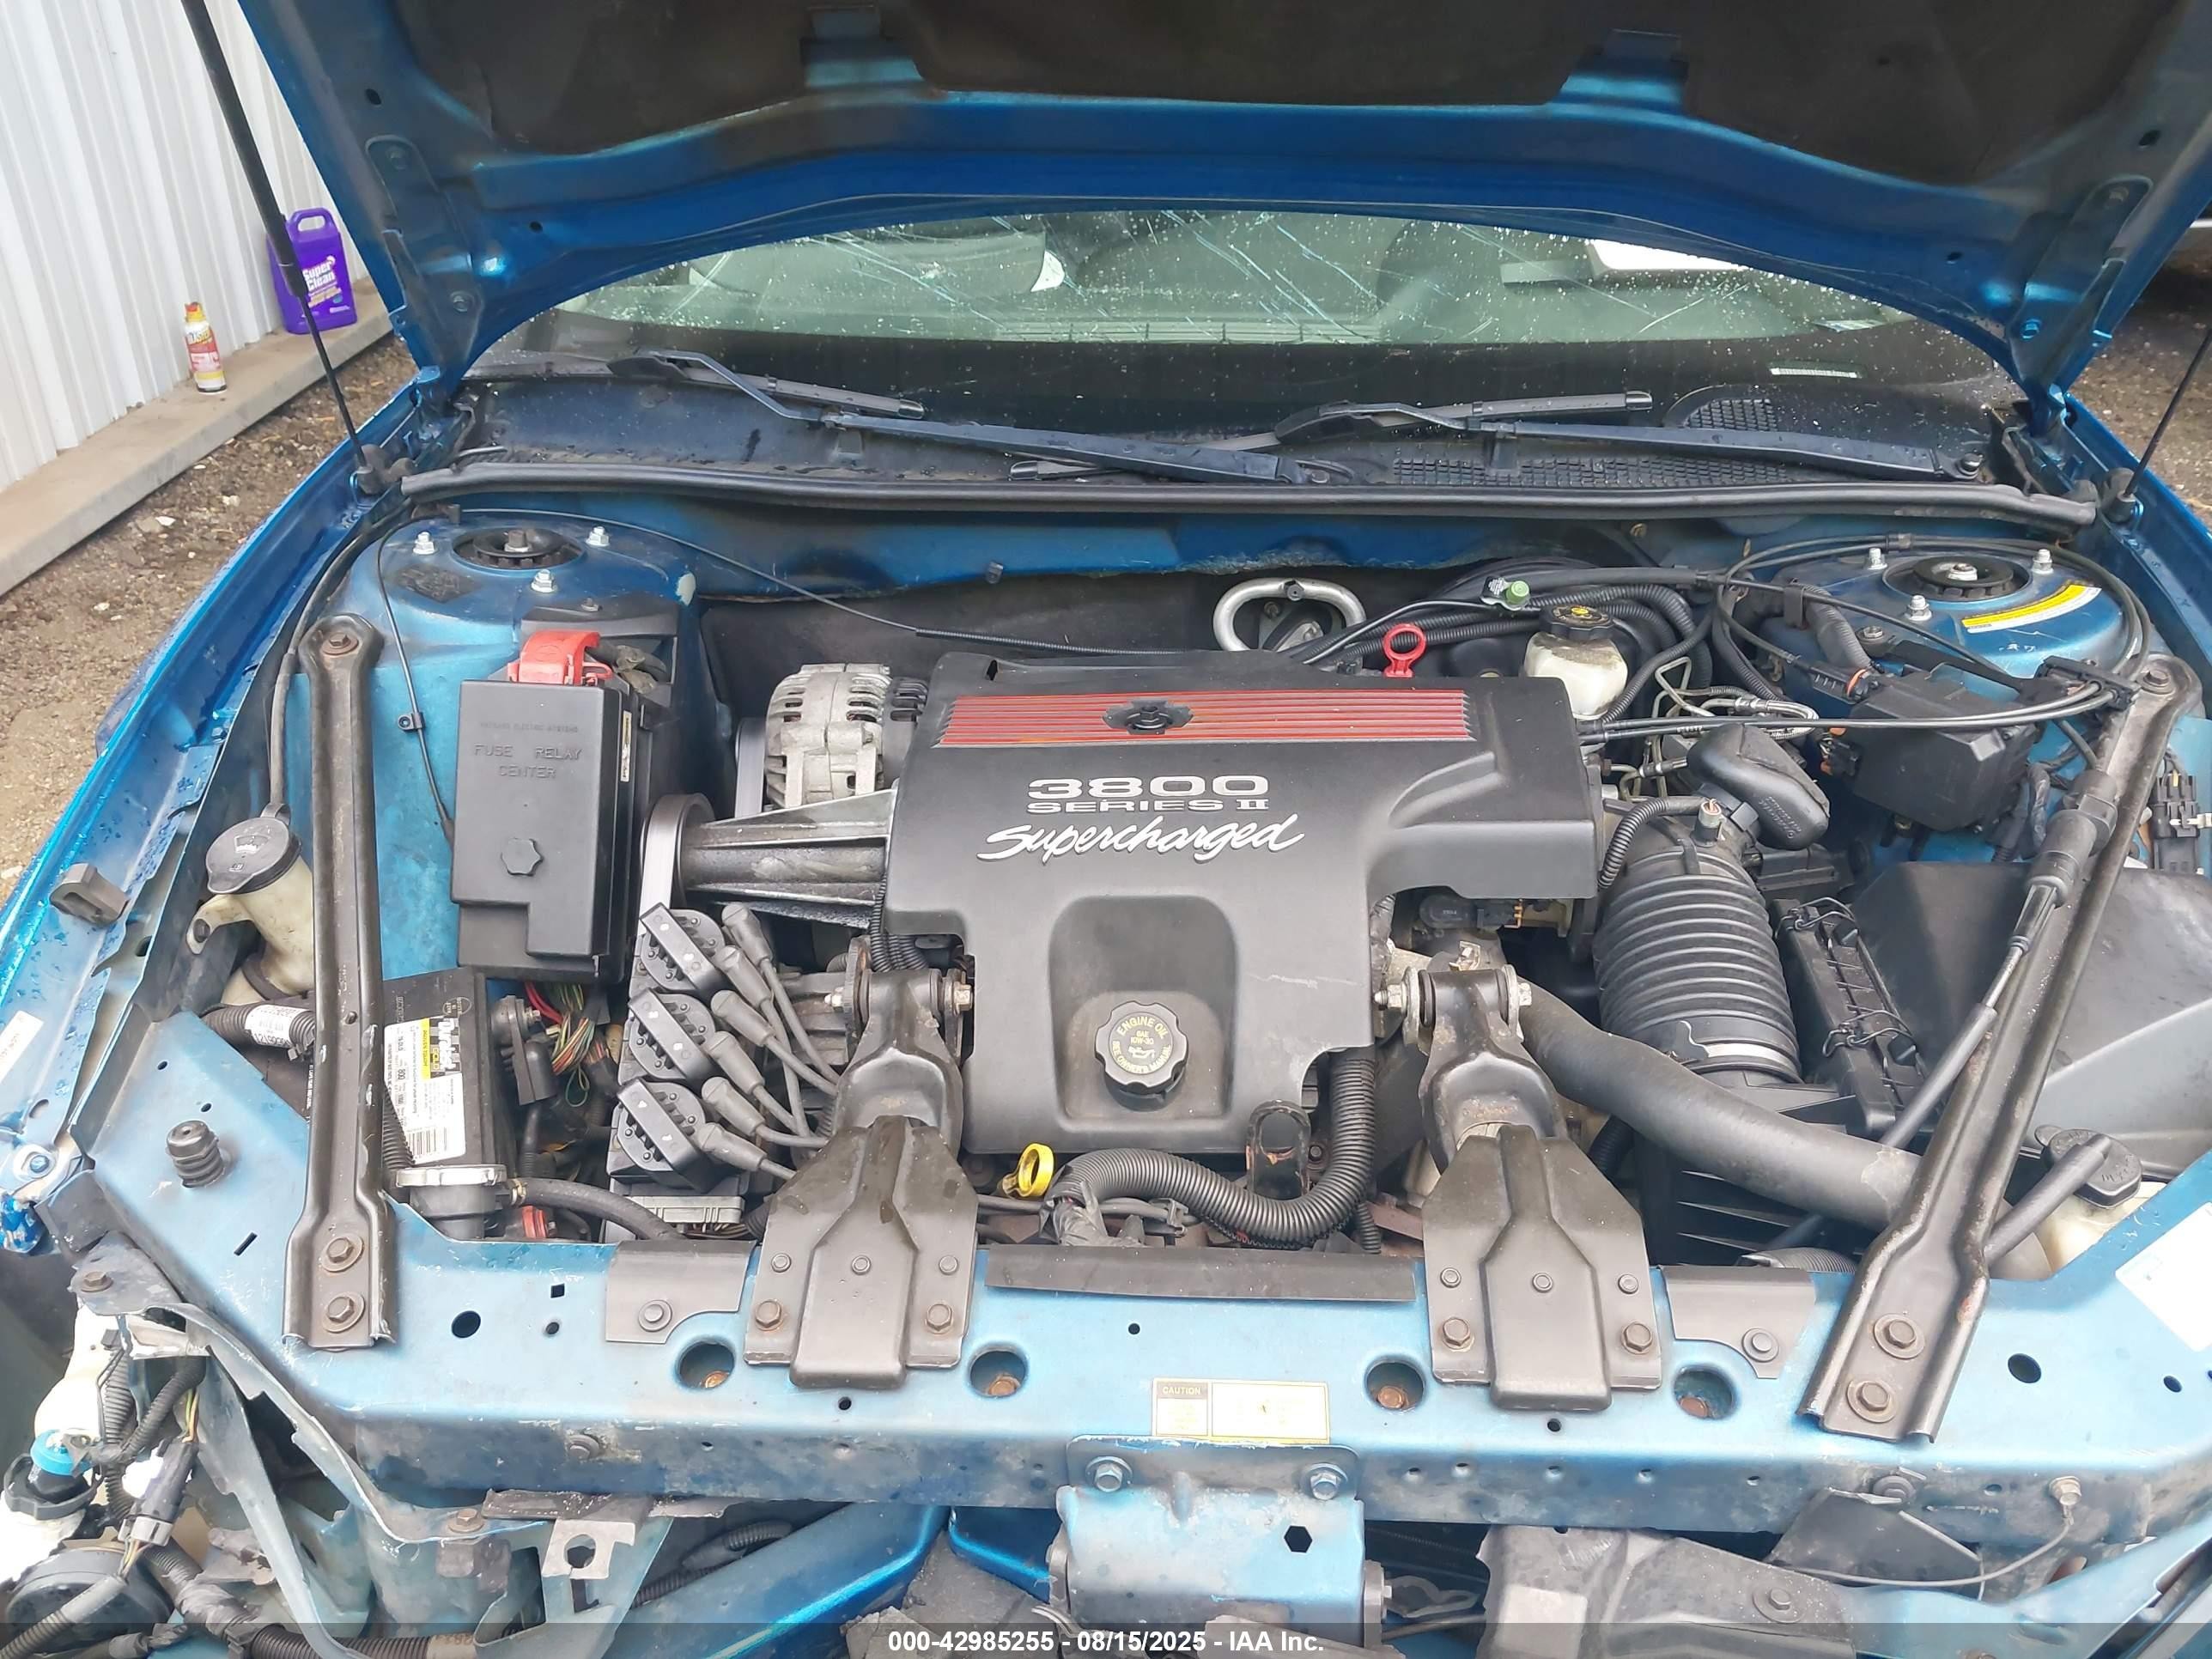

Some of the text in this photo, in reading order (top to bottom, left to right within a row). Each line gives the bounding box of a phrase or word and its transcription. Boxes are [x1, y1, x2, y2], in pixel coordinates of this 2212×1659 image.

[302, 260, 331, 281] Super
[306, 270, 336, 292] Clean
[474, 744, 583, 761] FUSE RELAY
[499, 764, 556, 779] CENTER
[1028, 775, 1269, 799] 3800
[1026, 798, 1270, 814] SERIES II
[976, 813, 1305, 866] Supercharged
[1116, 1016, 1169, 1039] ENGINE OIL
[438, 1018, 457, 1070] Duralast
[1130, 1036, 1155, 1045] 10W-30
[1112, 1041, 1171, 1073] SEE OWNER'S MANUAL
[1163, 1386, 1201, 1396] CAUTION
